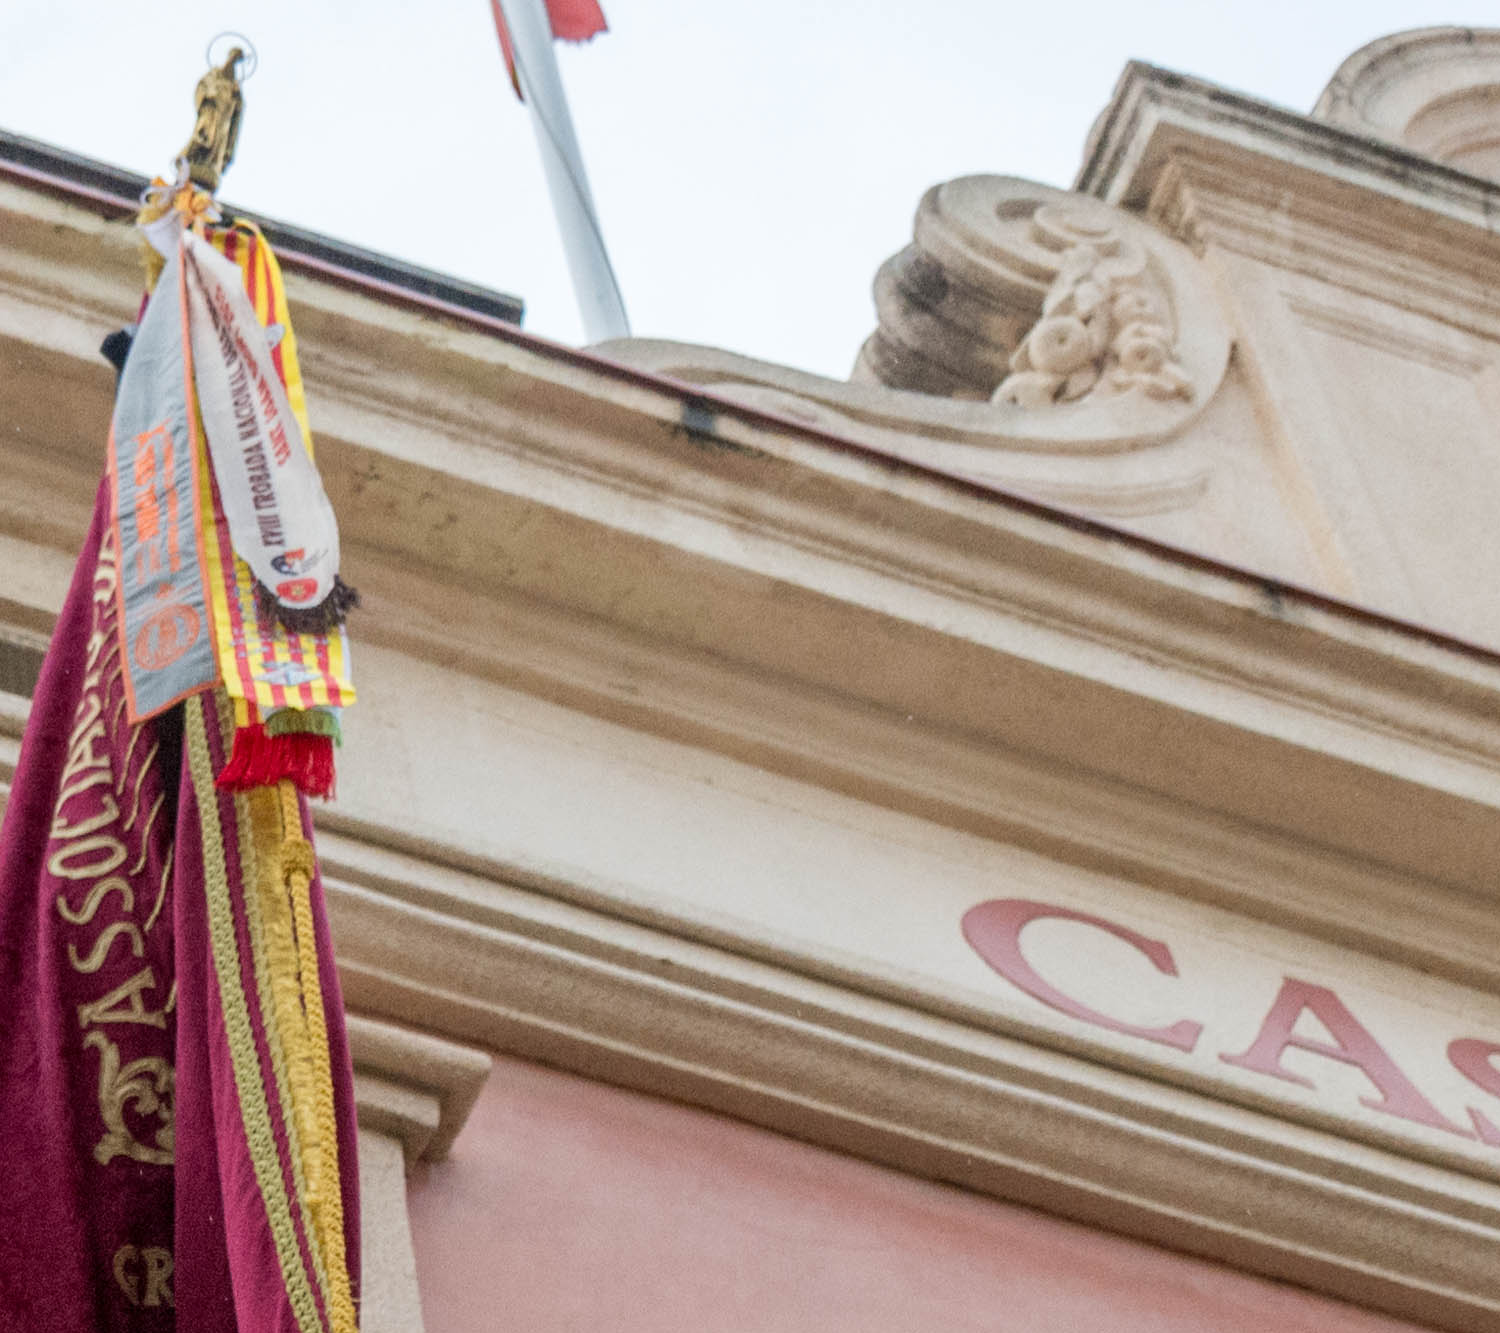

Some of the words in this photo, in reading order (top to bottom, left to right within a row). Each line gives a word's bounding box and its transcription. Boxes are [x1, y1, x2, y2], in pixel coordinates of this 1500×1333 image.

[229, 361, 260, 441] NACIONAL
[269, 420, 291, 468] SANT
[243, 441, 277, 511] TROBADA
[257, 514, 285, 547] XVIII
